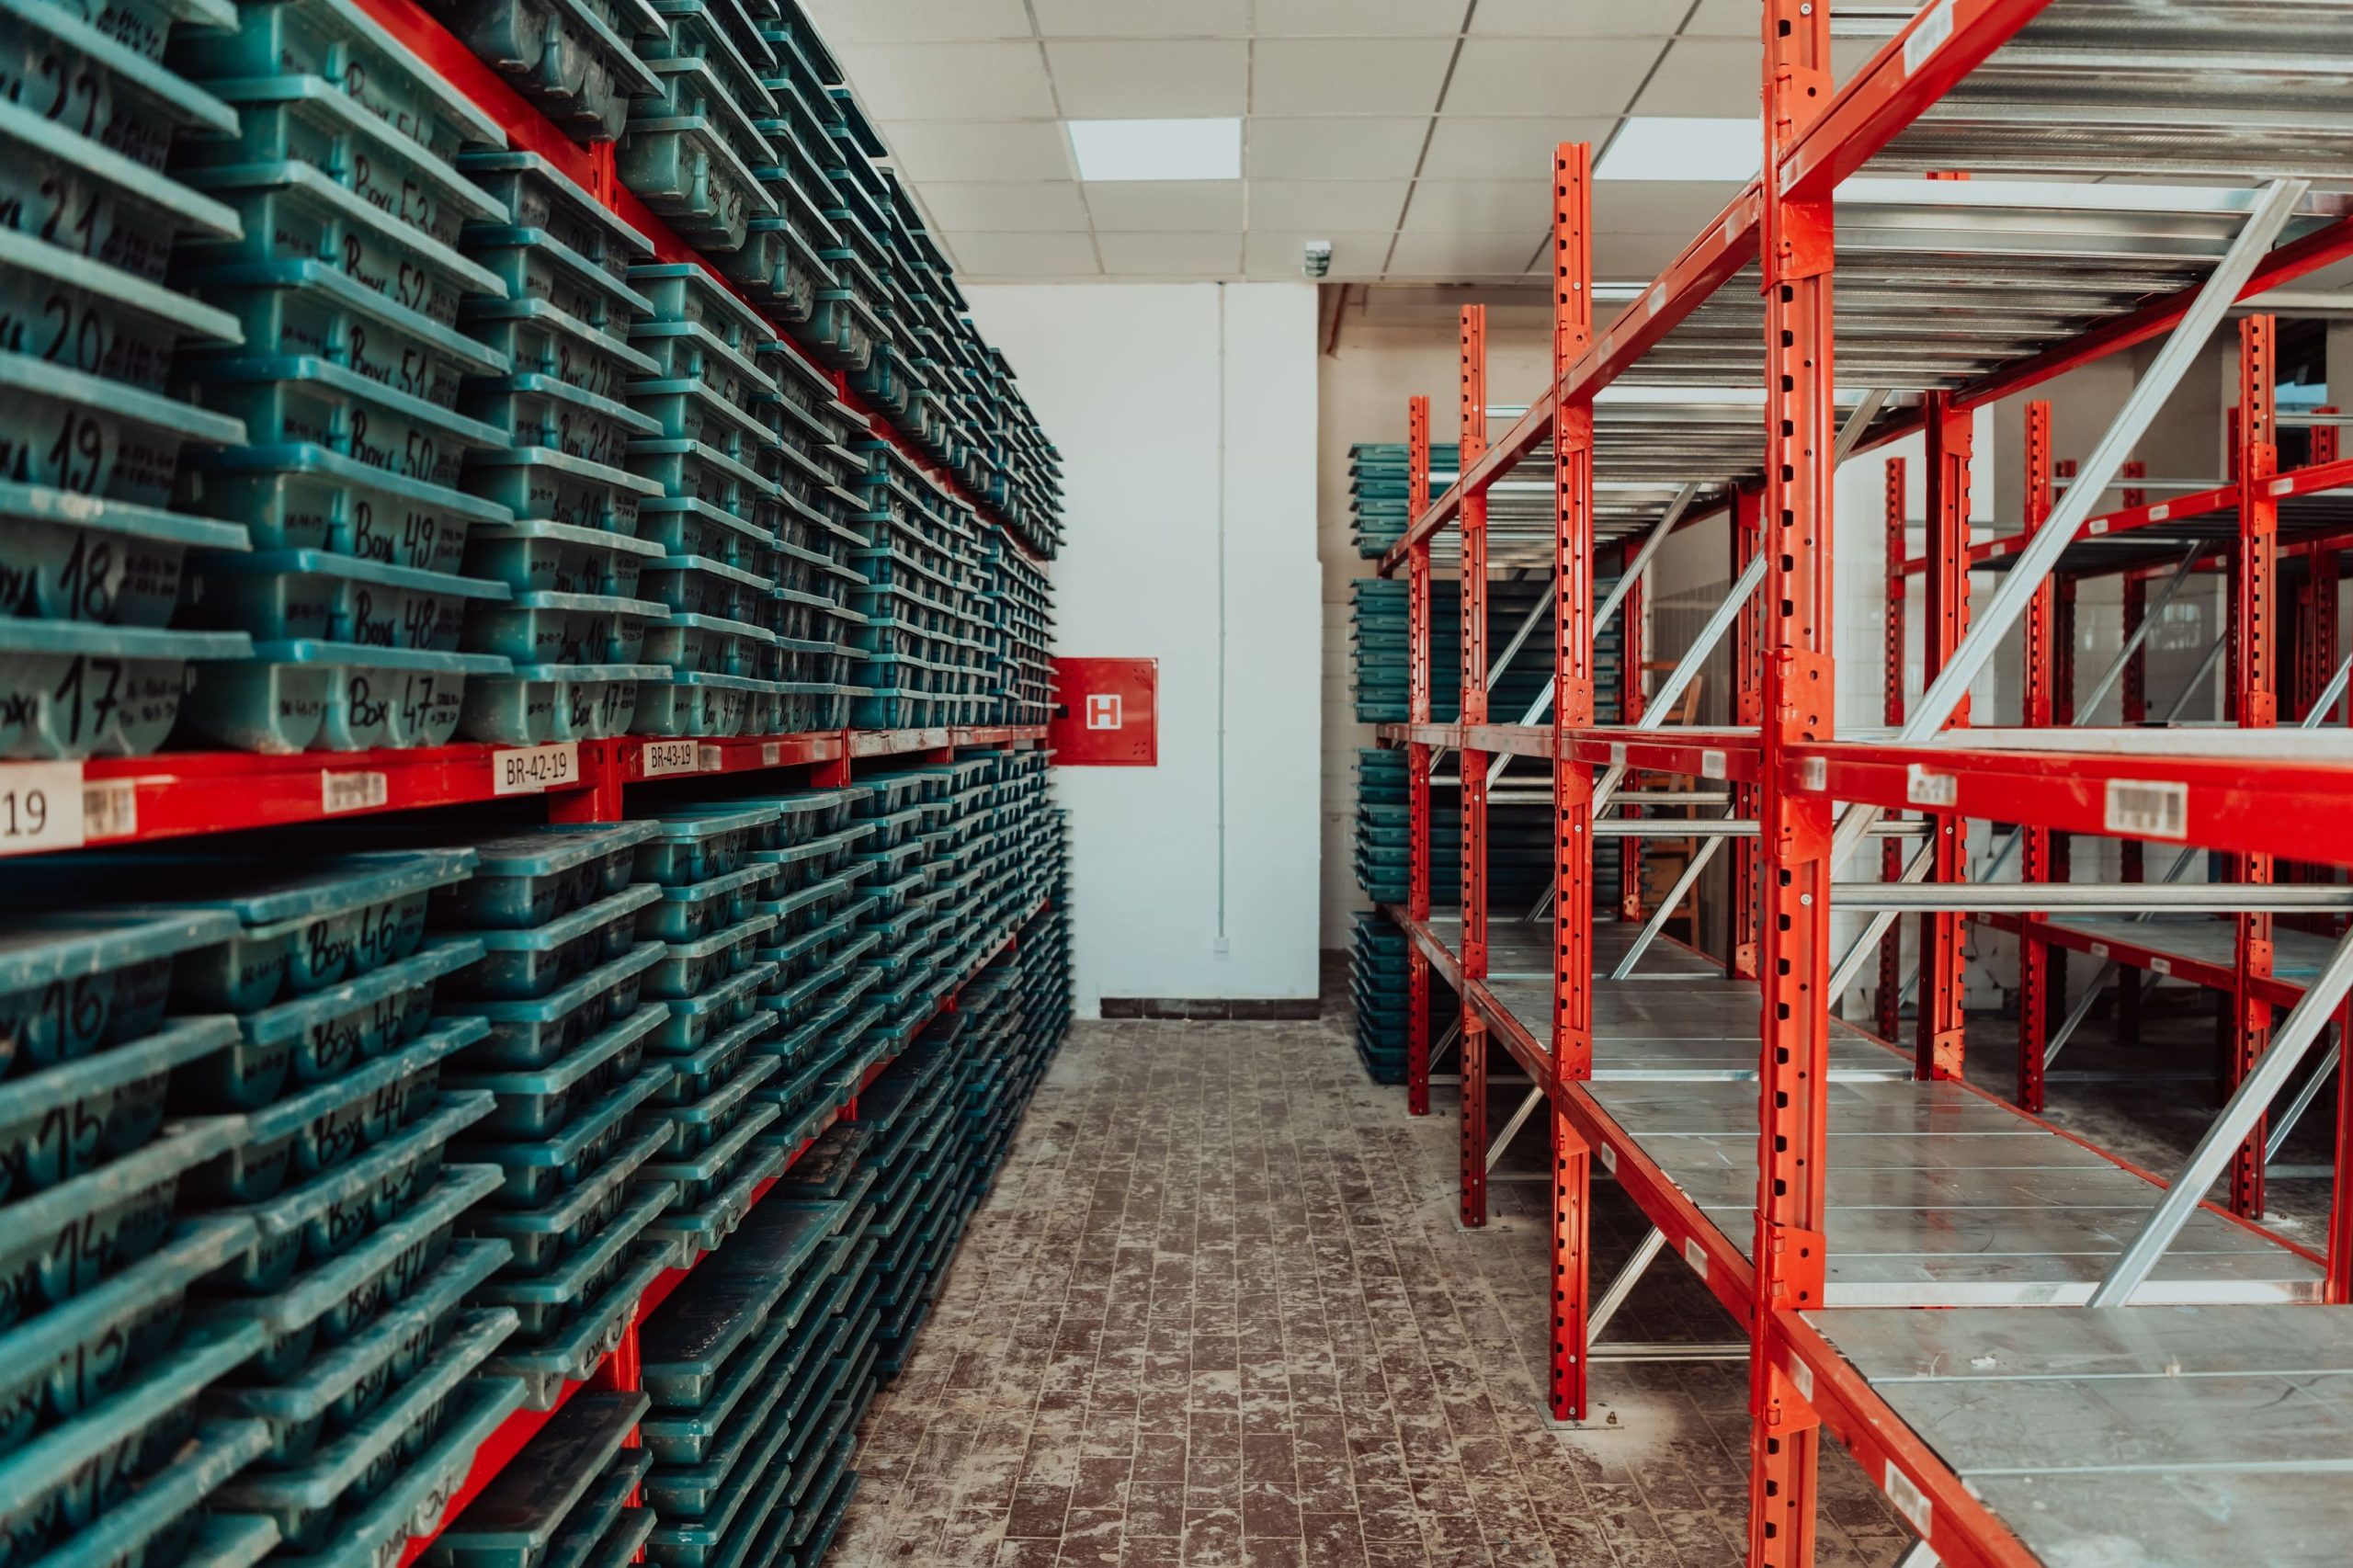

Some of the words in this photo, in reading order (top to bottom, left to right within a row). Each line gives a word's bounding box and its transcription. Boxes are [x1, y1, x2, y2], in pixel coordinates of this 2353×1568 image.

[43, 294, 104, 375] 20
[50, 409, 102, 494] 19
[354, 501, 395, 562] Box
[404, 509, 434, 569] 49
[60, 526, 110, 622] 18
[355, 589, 396, 647] Box
[404, 597, 436, 649] 48
[54, 653, 121, 746] 17
[348, 676, 390, 728] Box
[403, 674, 435, 734] 47
[601, 682, 620, 728] 17
[506, 752, 567, 786] BR-42-19
[651, 744, 691, 768] BR-43-19
[309, 920, 348, 978] Box
[361, 903, 395, 962] 46
[42, 972, 103, 1059] 16
[313, 1019, 359, 1069] Box
[39, 1099, 103, 1176] 15
[314, 1112, 363, 1166] Box
[374, 1081, 403, 1138] 44
[55, 1211, 116, 1297] 14
[329, 1201, 368, 1247] Box
